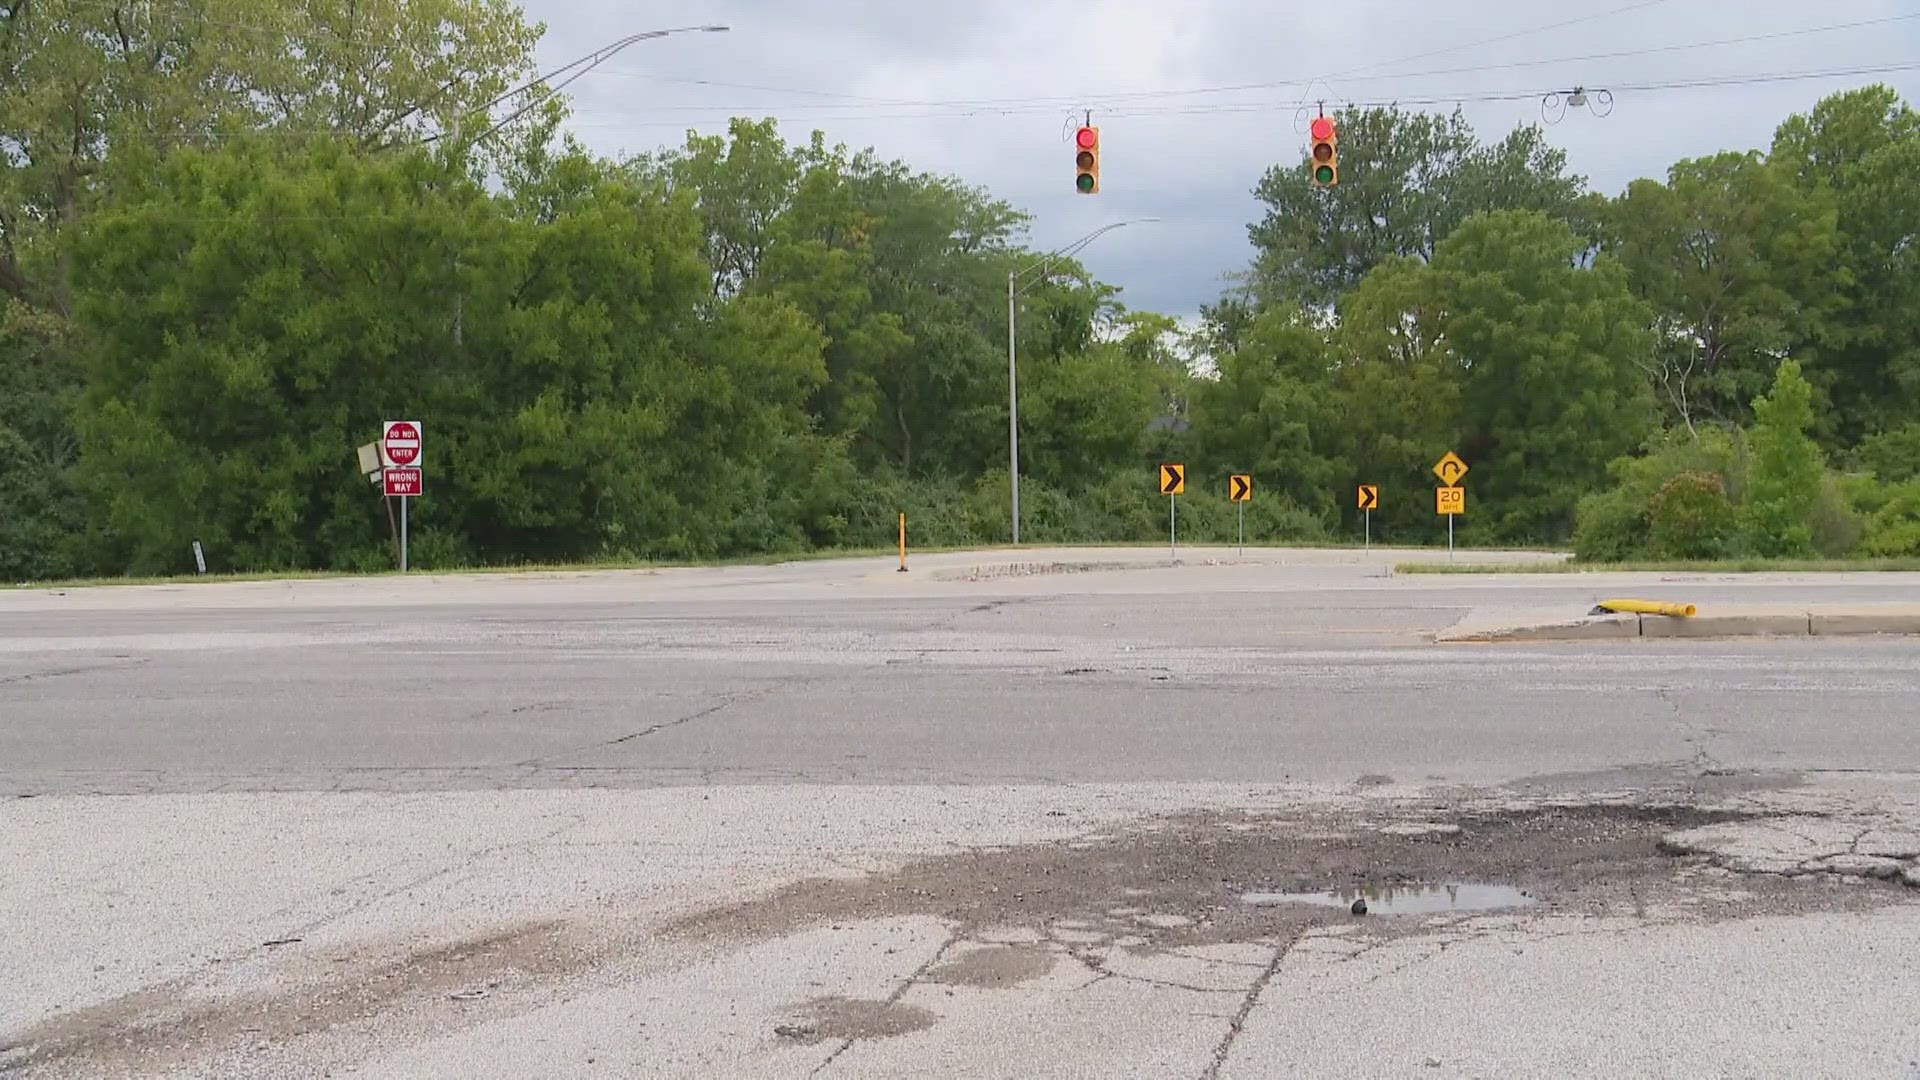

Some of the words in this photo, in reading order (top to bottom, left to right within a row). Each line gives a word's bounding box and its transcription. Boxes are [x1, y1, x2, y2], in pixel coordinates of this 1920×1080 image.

[389, 430, 400, 438] DO
[402, 430, 415, 438] NOT
[392, 449, 413, 458] ENTER
[388, 472, 417, 482] WRONG
[394, 483, 412, 492] WAY
[1441, 491, 1461, 502] 20
